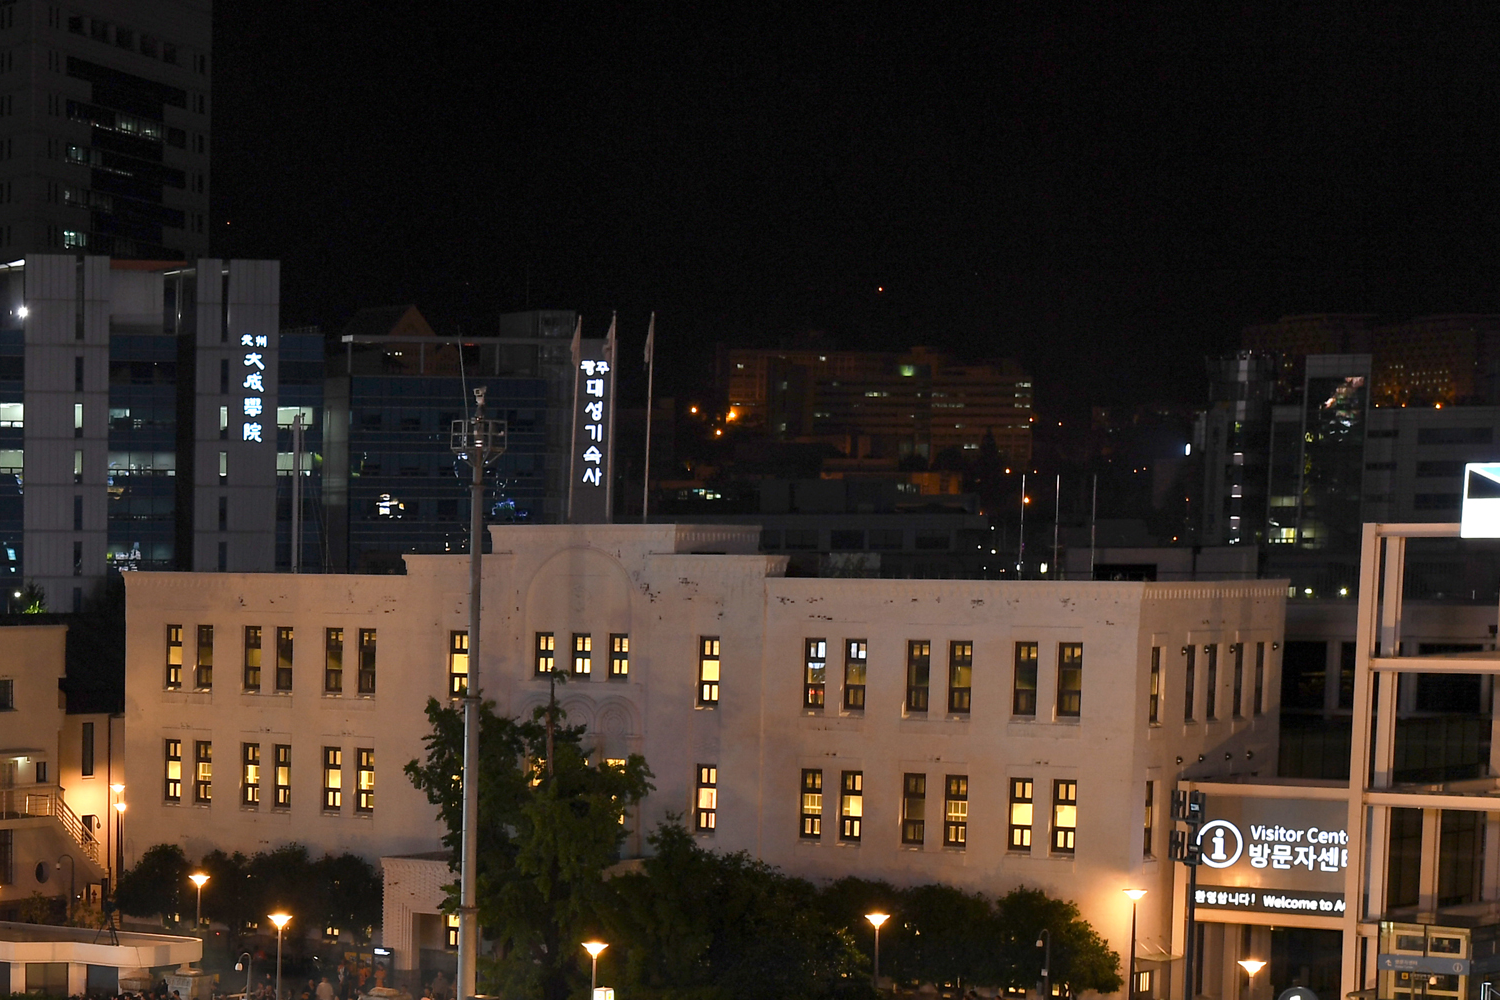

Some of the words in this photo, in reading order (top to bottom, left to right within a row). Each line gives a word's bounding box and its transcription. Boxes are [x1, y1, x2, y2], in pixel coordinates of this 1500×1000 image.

[579, 360, 610, 376] 광주
[242, 352, 265, 443] 大成學院
[582, 378, 605, 487] 대성기숙사
[1250, 825, 1304, 842] Visitor
[1263, 894, 1318, 911] Welcome
[1319, 898, 1333, 911] to
